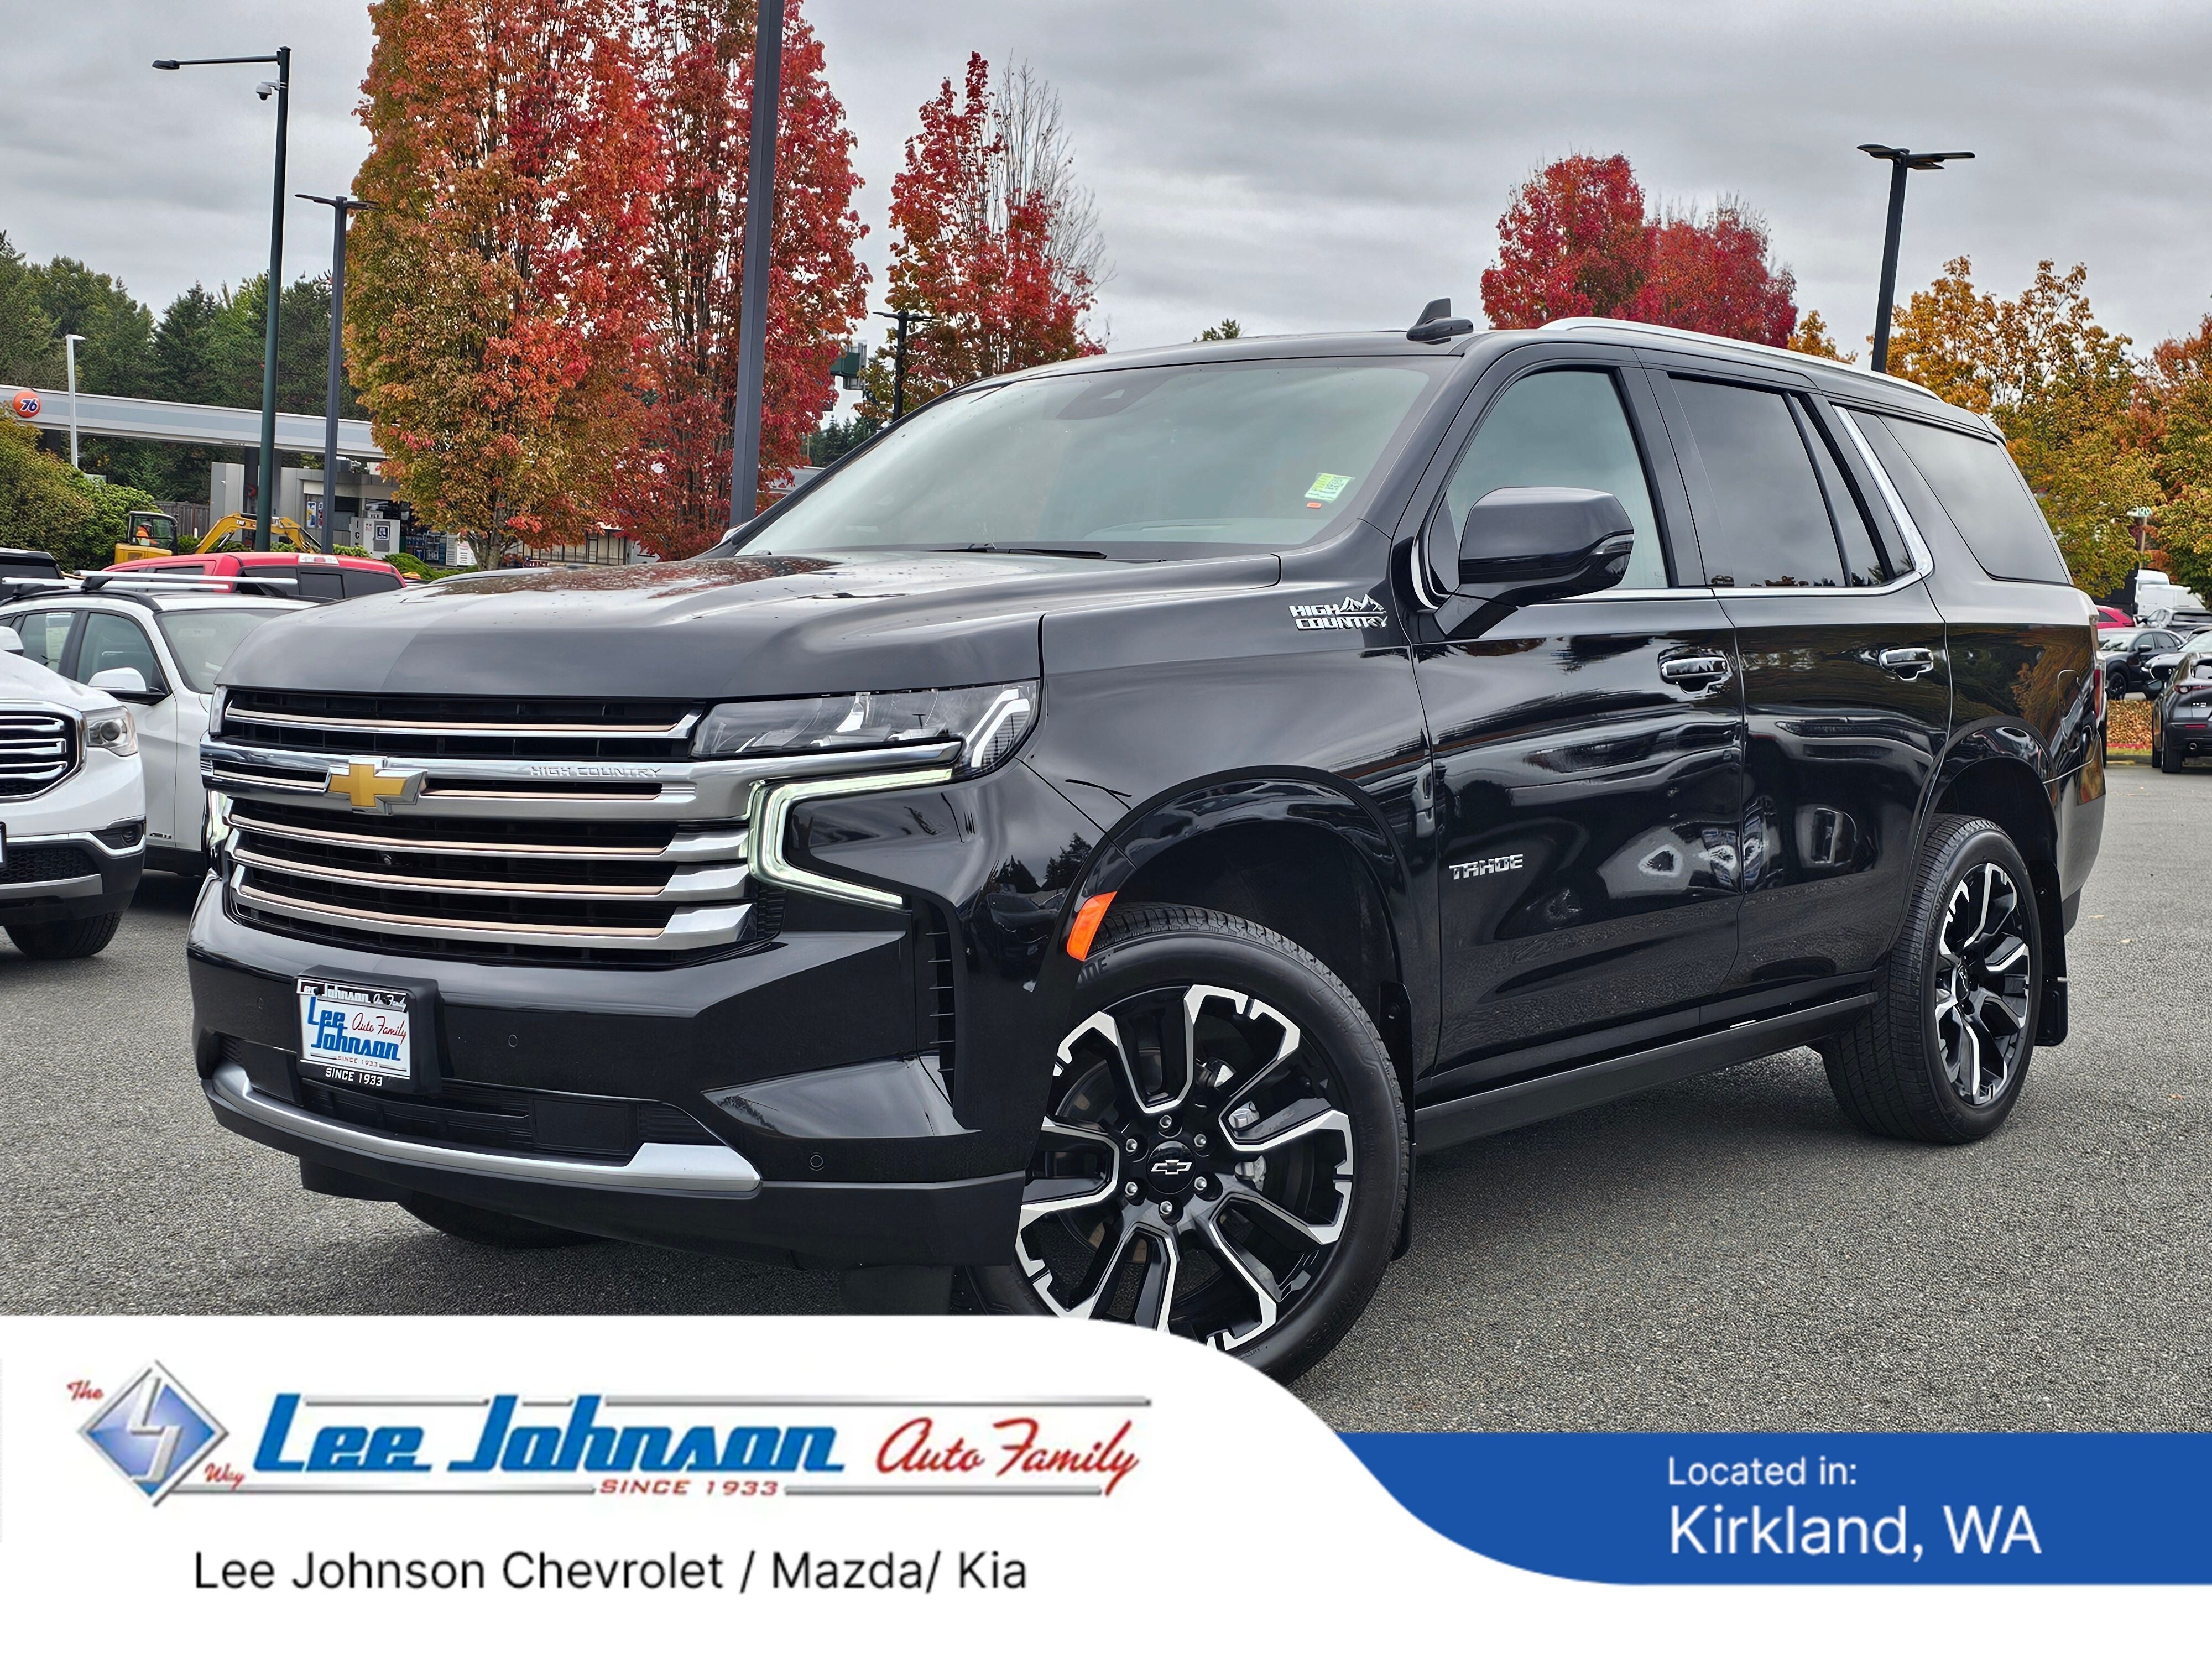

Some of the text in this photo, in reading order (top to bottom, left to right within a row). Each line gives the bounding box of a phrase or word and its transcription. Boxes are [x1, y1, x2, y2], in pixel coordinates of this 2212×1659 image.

[20, 398, 39, 413] 76
[1289, 604, 1340, 617] HIGH
[1296, 616, 1388, 630] COUNTRY
[530, 766, 661, 778] HIGH COUNTRY
[1449, 854, 1523, 880] TAHOE
[307, 997, 406, 1045] Lee Auto Family
[311, 1024, 401, 1061] Johnson
[337, 1055, 358, 1064] SINCE
[325, 1067, 383, 1087] SINCE 1933
